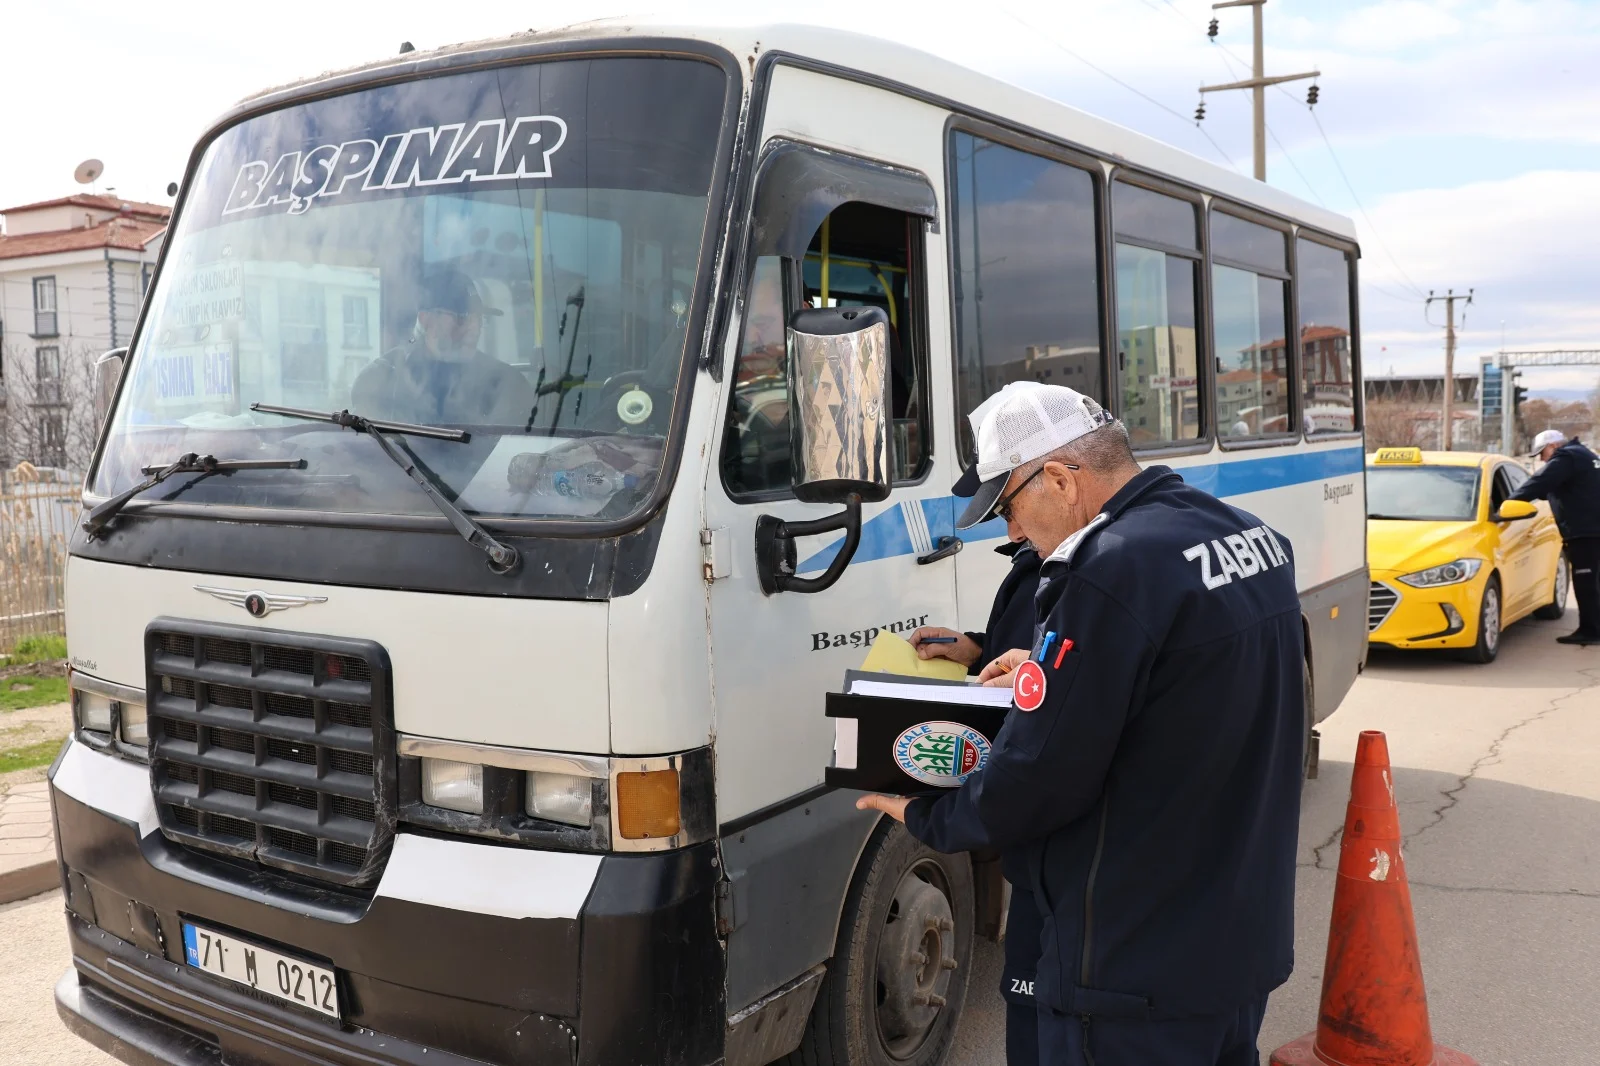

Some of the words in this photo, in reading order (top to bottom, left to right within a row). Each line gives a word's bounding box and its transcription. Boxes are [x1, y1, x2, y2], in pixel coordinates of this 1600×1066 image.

[222, 115, 567, 215] BAŞPINAR
[154, 355, 195, 398] OSMAN
[1323, 483, 1354, 504] Başpınar
[1182, 525, 1289, 590] ZABITA
[964, 748, 974, 767] 1939
[189, 947, 198, 960] TR
[200, 933, 225, 973] 71
[244, 948, 258, 985] M
[277, 959, 335, 1012] 0212
